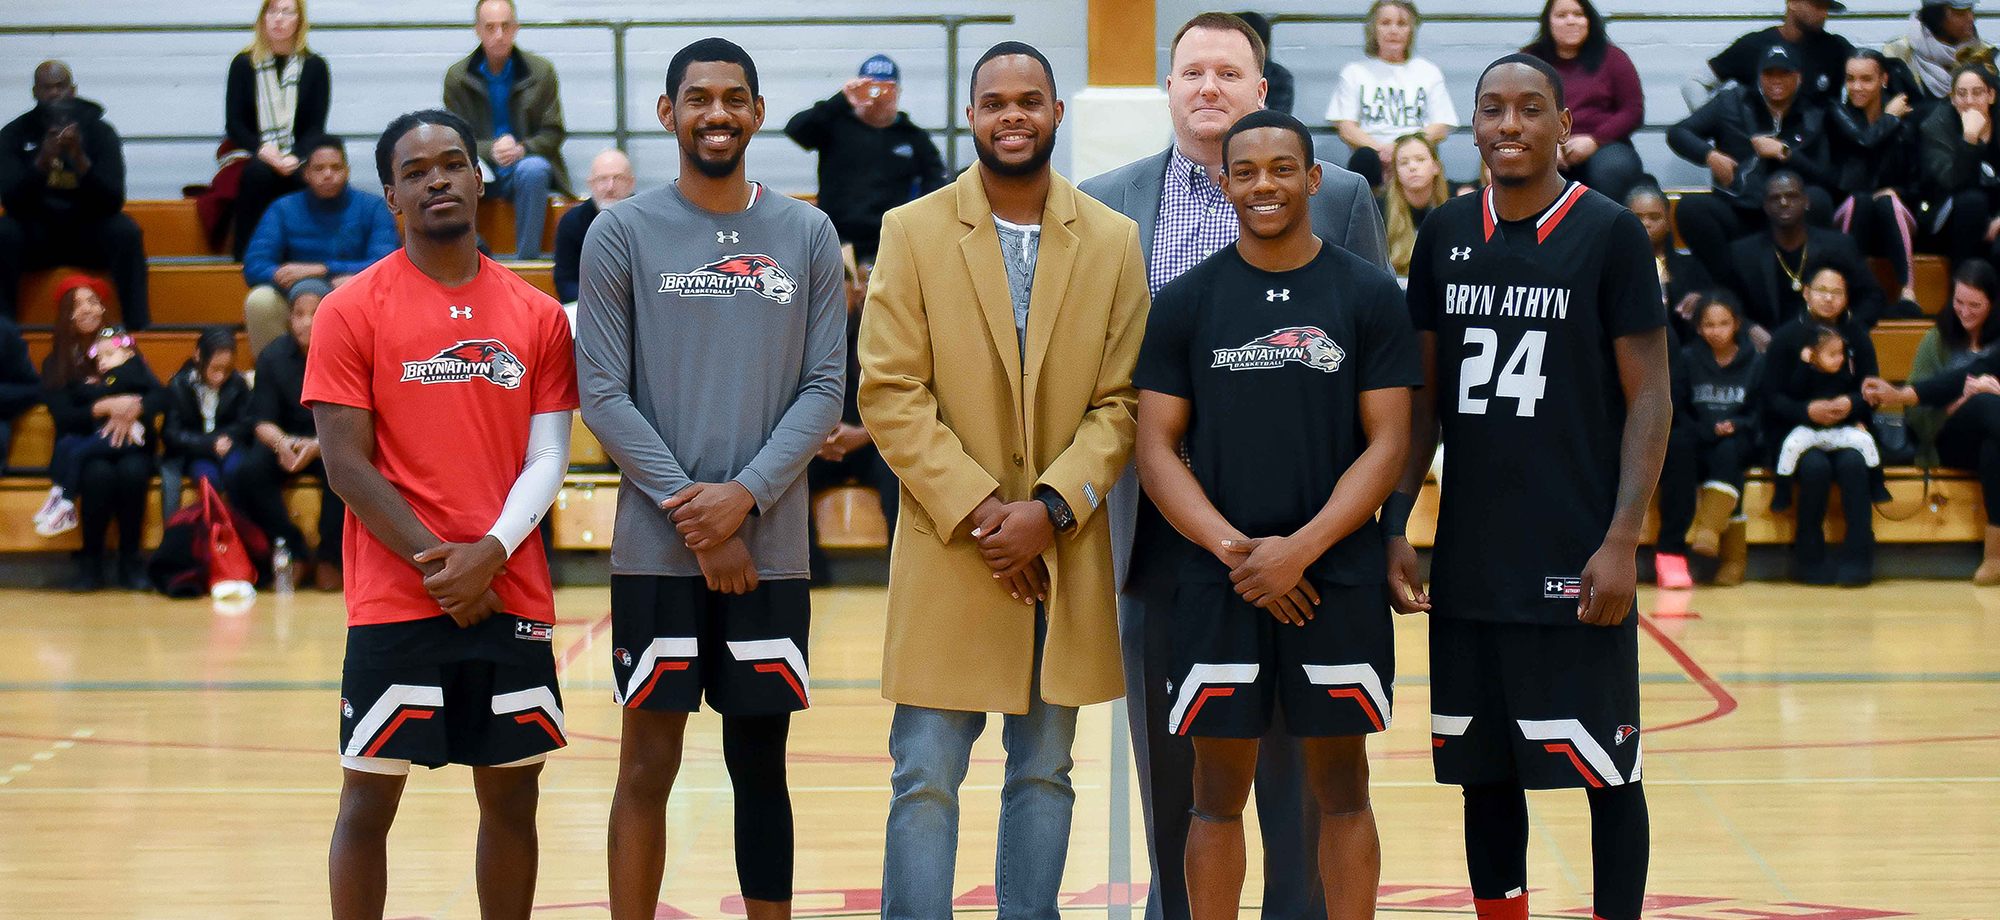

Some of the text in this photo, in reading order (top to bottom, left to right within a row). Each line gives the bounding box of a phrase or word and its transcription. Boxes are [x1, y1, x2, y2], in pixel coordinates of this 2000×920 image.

[1373, 87, 1406, 106] AM
[1415, 87, 1427, 106] A
[1445, 283, 1571, 320] BRYN ATHYN
[1458, 327, 1547, 417] 24
